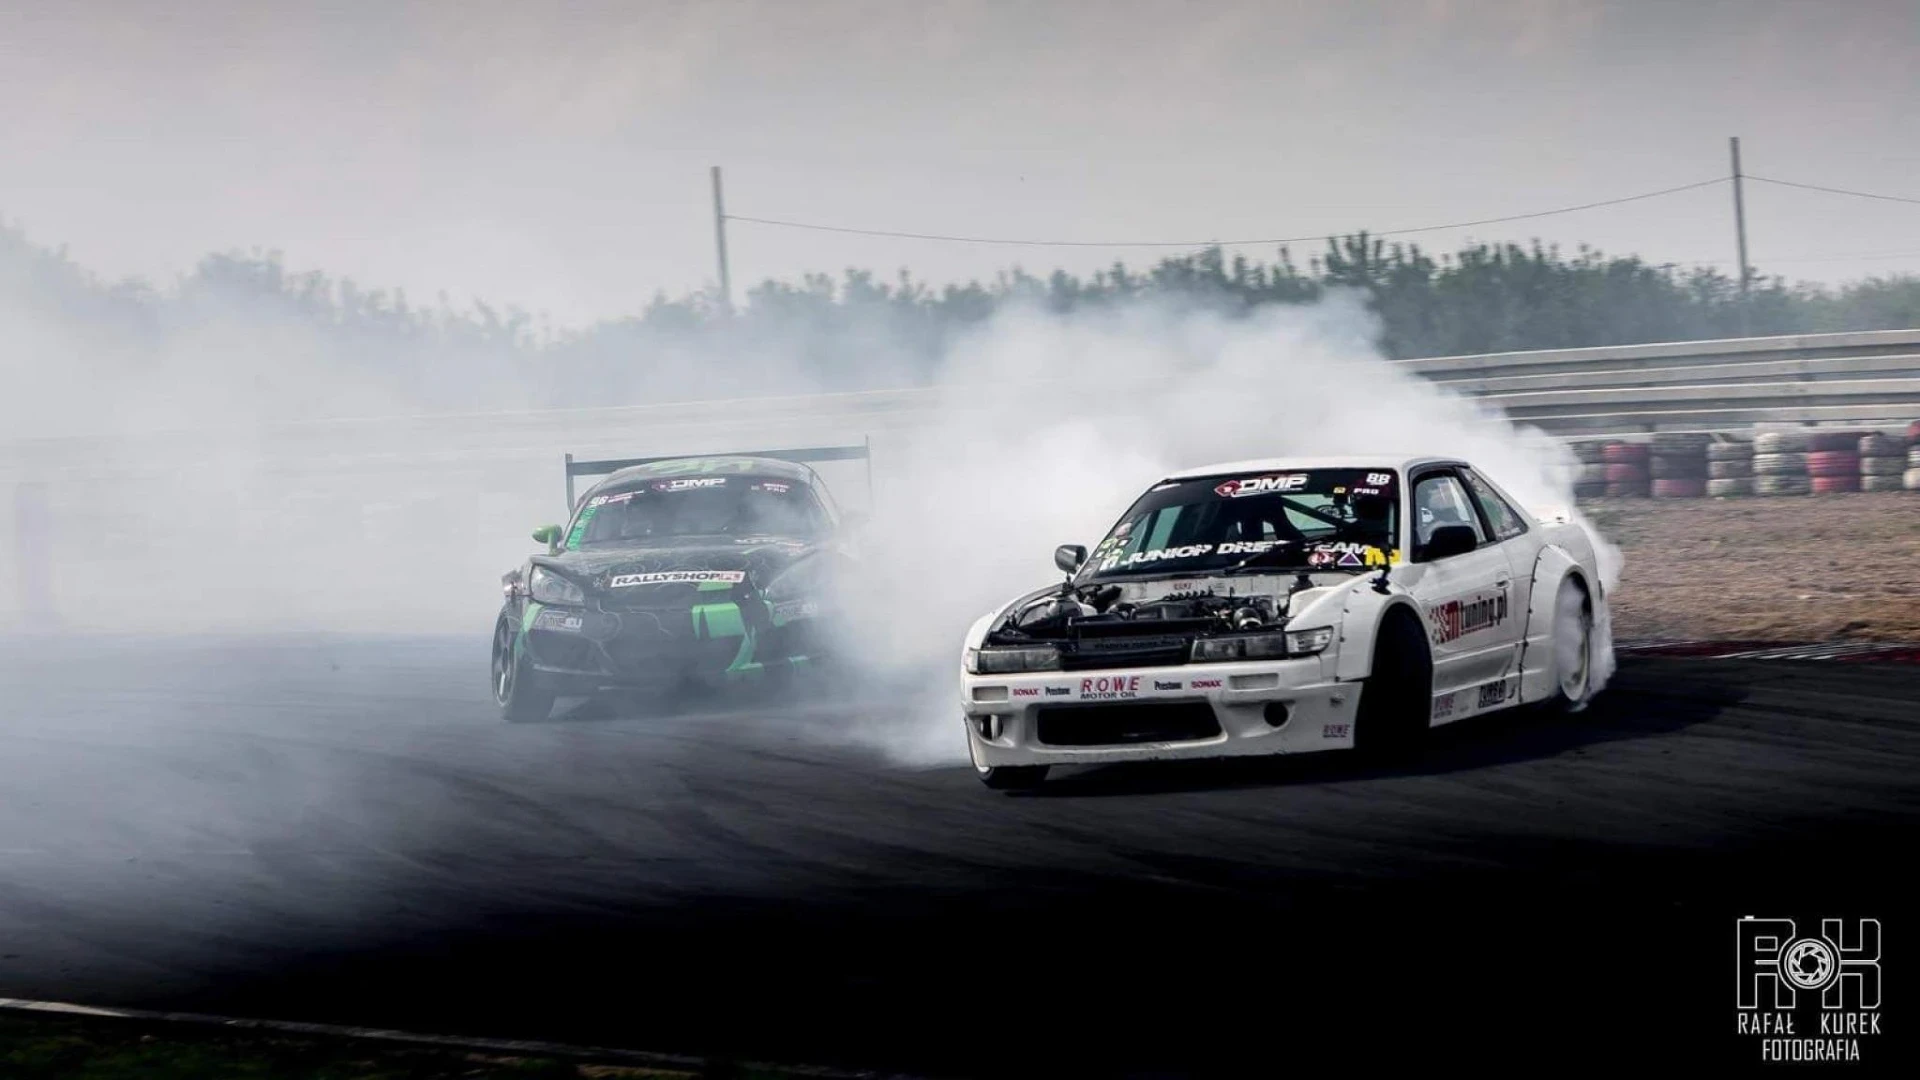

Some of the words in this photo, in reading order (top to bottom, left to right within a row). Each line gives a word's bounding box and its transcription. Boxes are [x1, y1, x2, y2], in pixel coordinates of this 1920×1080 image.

[671, 478, 727, 490] DMP
[1239, 475, 1308, 492] DMP
[1353, 487, 1380, 495] PRO
[1120, 544, 1213, 566] JUNIOR
[1080, 676, 1140, 691] ROWE
[1190, 680, 1222, 690] SONAX
[1013, 688, 1039, 696] SONAX
[1080, 691, 1117, 700] MOTOR
[1120, 690, 1137, 699] OIL
